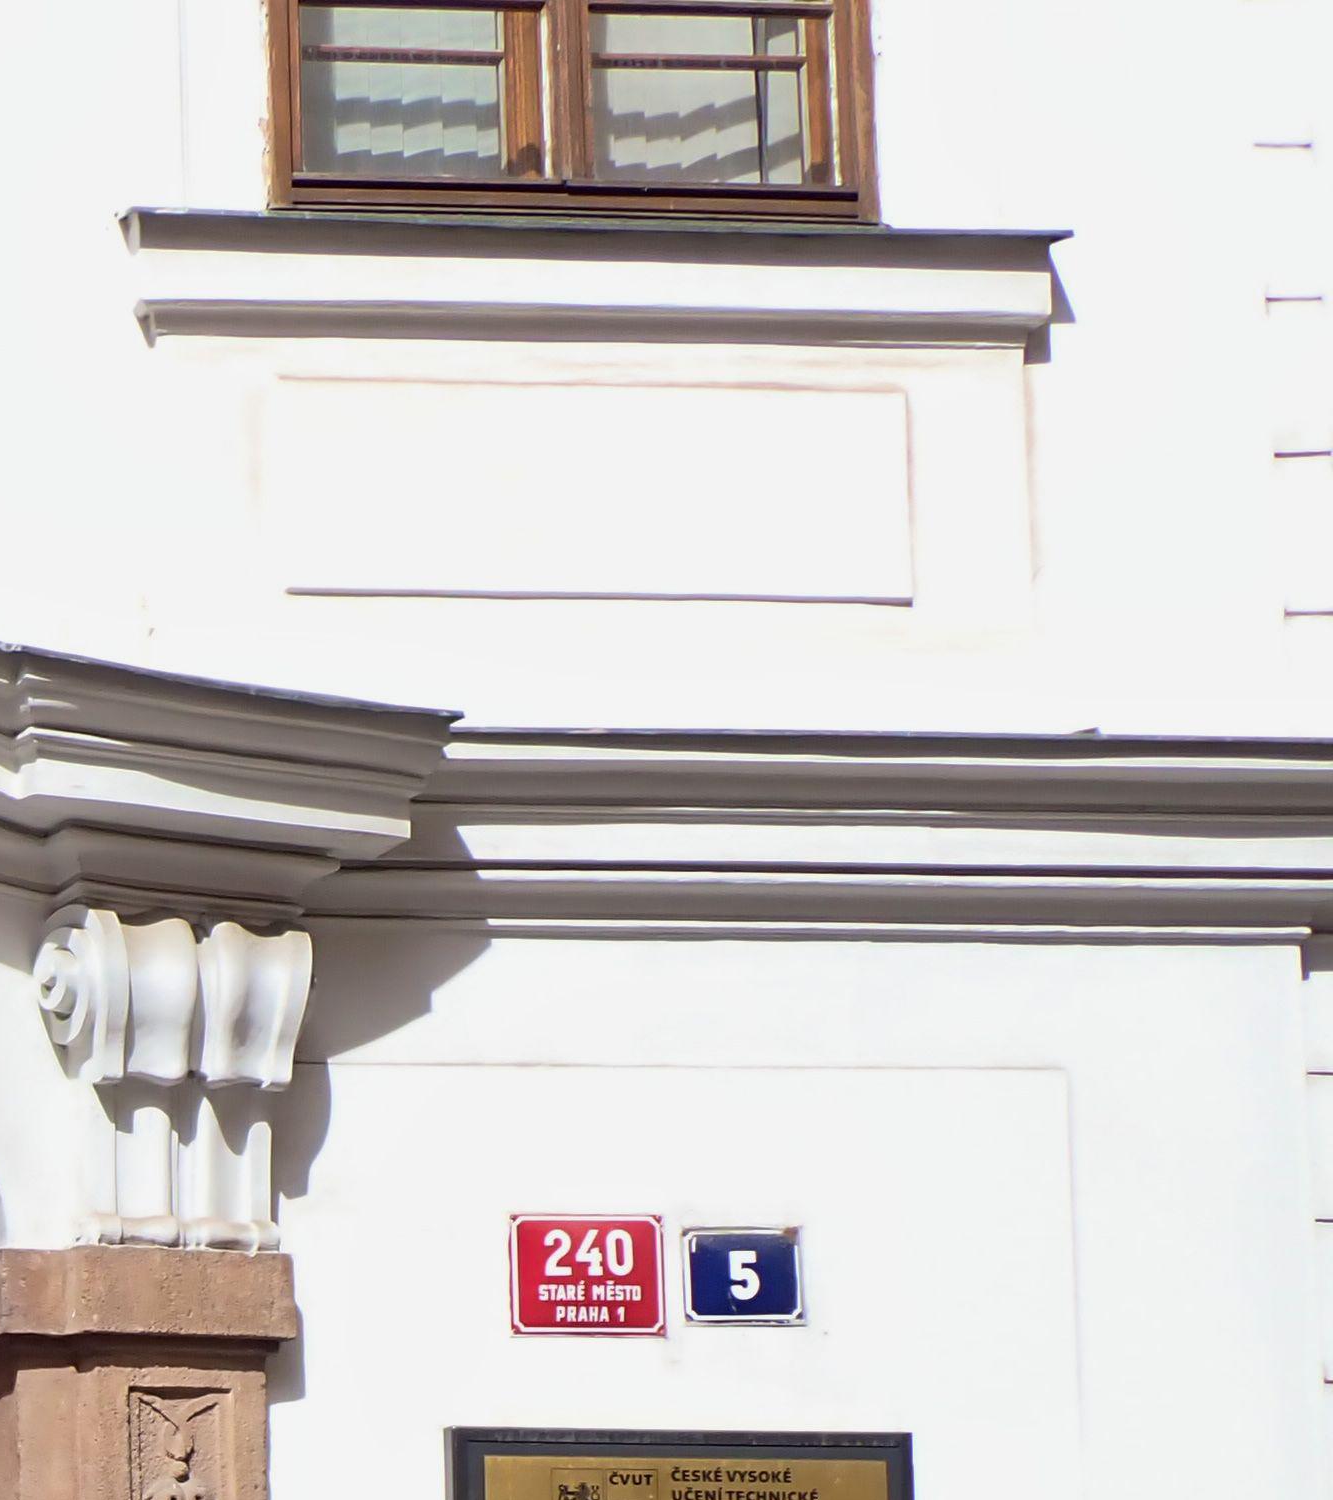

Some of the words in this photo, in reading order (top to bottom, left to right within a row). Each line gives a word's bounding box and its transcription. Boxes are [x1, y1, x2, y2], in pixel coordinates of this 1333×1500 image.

[543, 1228, 634, 1277] 240
[729, 1250, 761, 1301] 5
[538, 1281, 586, 1301] STARÉ
[592, 1280, 642, 1301] MĚSTO
[555, 1306, 609, 1323] PRAHA
[617, 1306, 625, 1323] 1
[609, 1471, 653, 1486] ČVUT
[671, 1467, 723, 1483] ČESKÉ
[726, 1468, 792, 1484] VYSOKÉ
